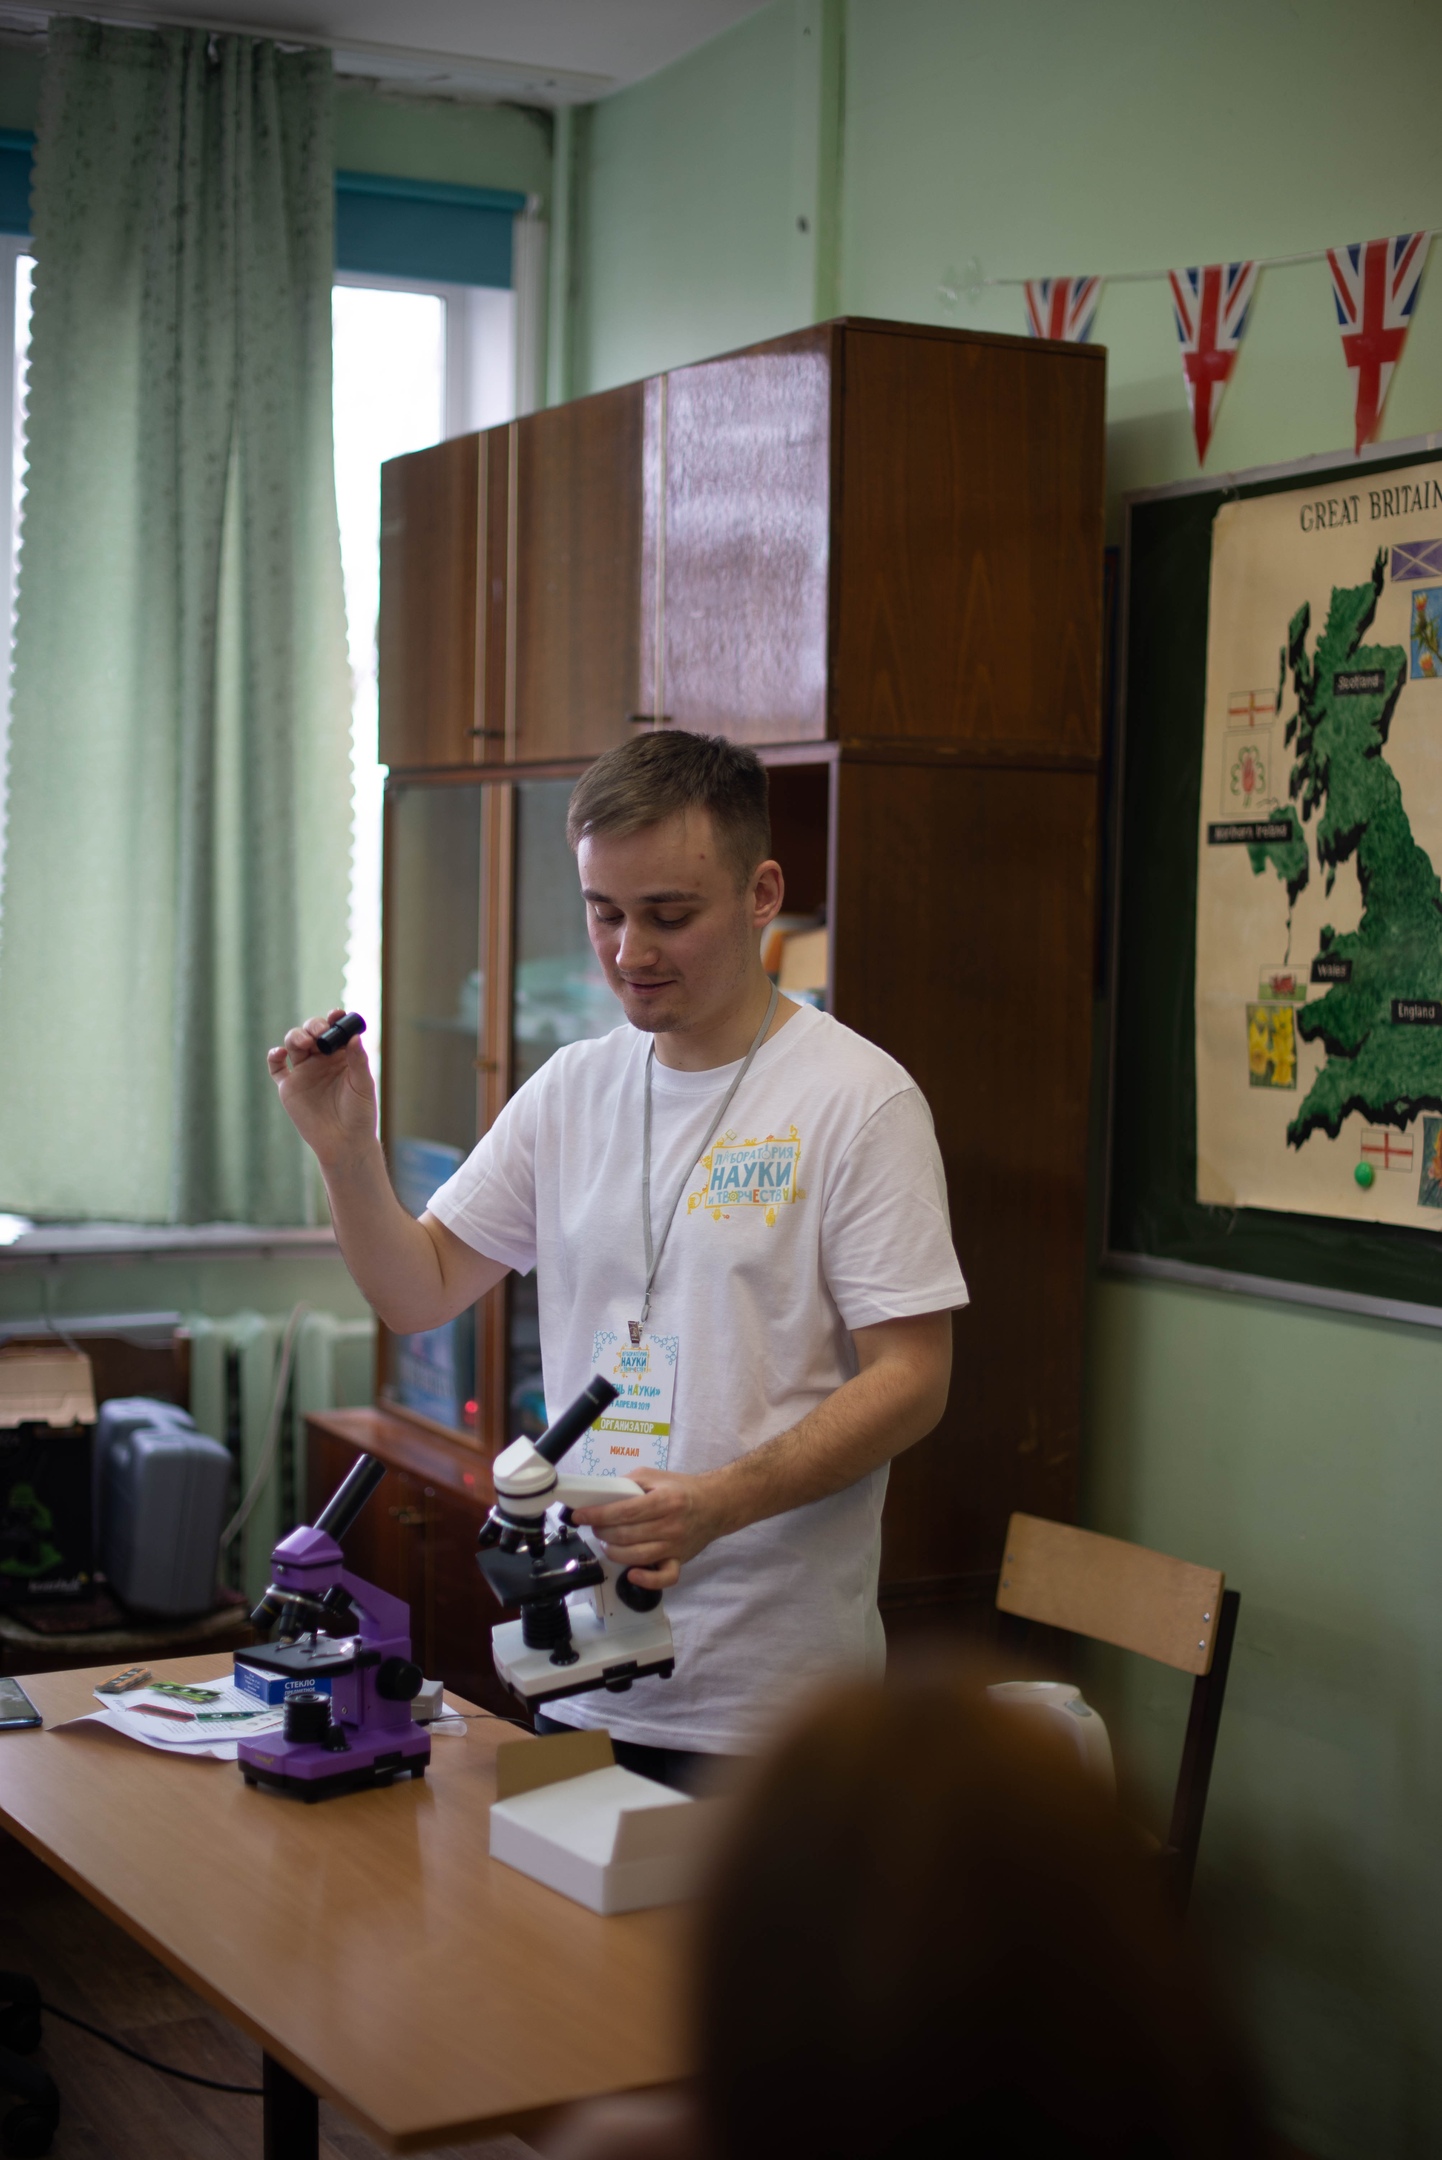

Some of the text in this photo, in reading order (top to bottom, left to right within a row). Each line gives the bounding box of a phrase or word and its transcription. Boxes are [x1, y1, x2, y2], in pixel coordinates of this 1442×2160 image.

[1300, 494, 1360, 532] GREAT
[1337, 673, 1380, 690] Scotland
[1317, 960, 1347, 977] Wales
[1398, 1003, 1436, 1020] England
[710, 1161, 792, 1191] НАУКИ
[621, 1357, 647, 1367] НАУКИ
[615, 1400, 638, 1409] АПРЕЛЯ
[600, 1419, 654, 1433] ОРГАНИЗАТОР
[610, 1445, 640, 1457] МИХАИЛ
[285, 1679, 316, 1690] СТЕКЛО
